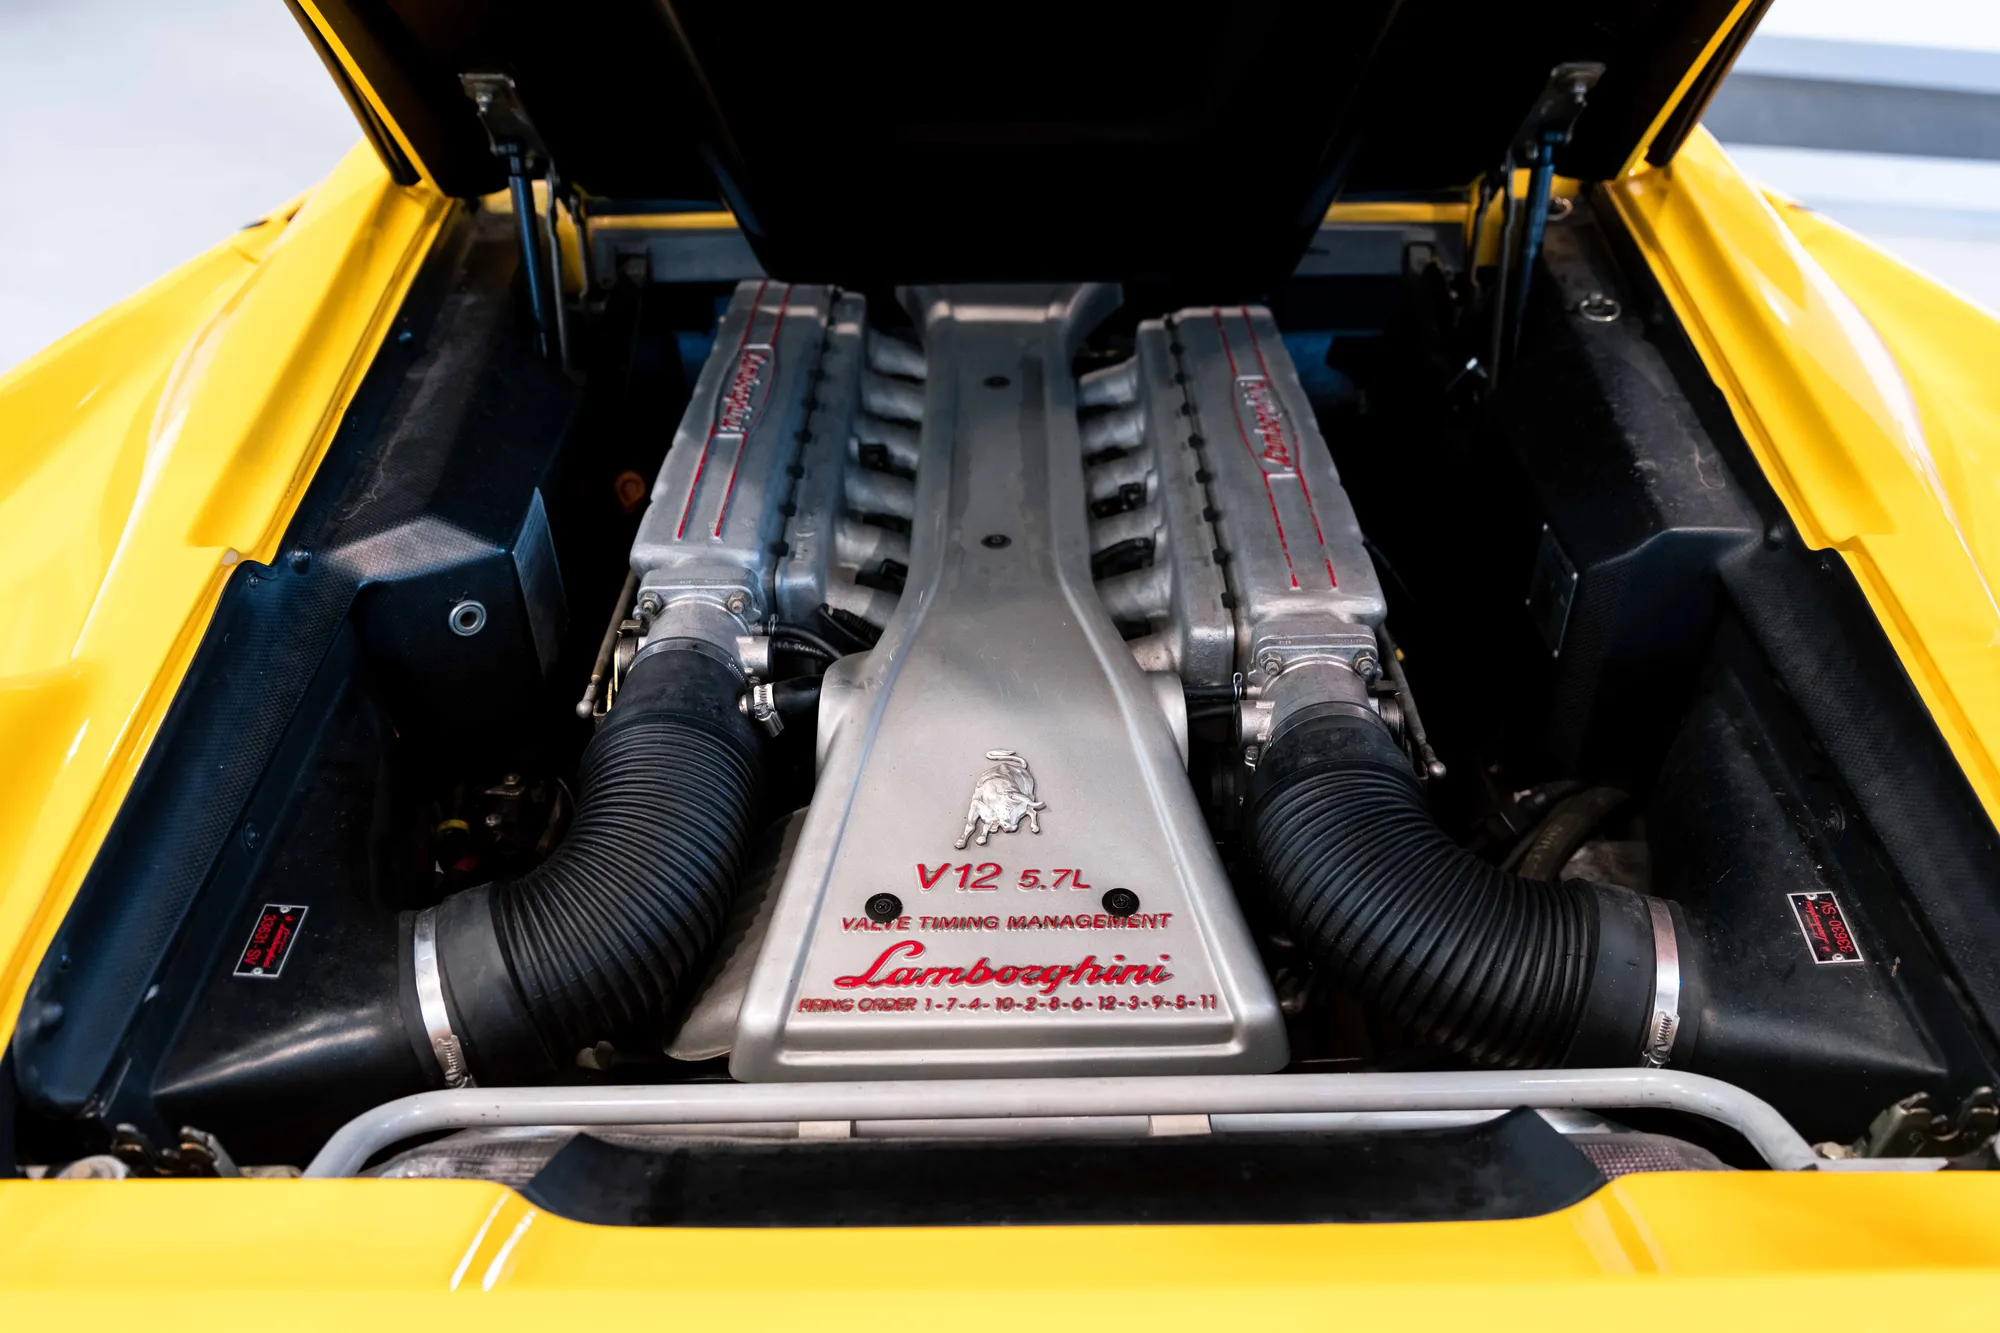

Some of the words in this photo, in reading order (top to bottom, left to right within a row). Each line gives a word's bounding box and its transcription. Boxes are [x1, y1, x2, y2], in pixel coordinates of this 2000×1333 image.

[915, 862, 1004, 892] V12
[1017, 868, 1092, 891] 5.7L
[243, 913, 277, 966] 33631-SV
[919, 915, 999, 932] TIMING
[1006, 912, 1173, 931] MANAGEMENT
[1818, 900, 1854, 953] 33630-SV
[831, 938, 1174, 997] Lamborghini
[797, 997, 856, 1013] FIRING
[857, 996, 918, 1013] ORDER
